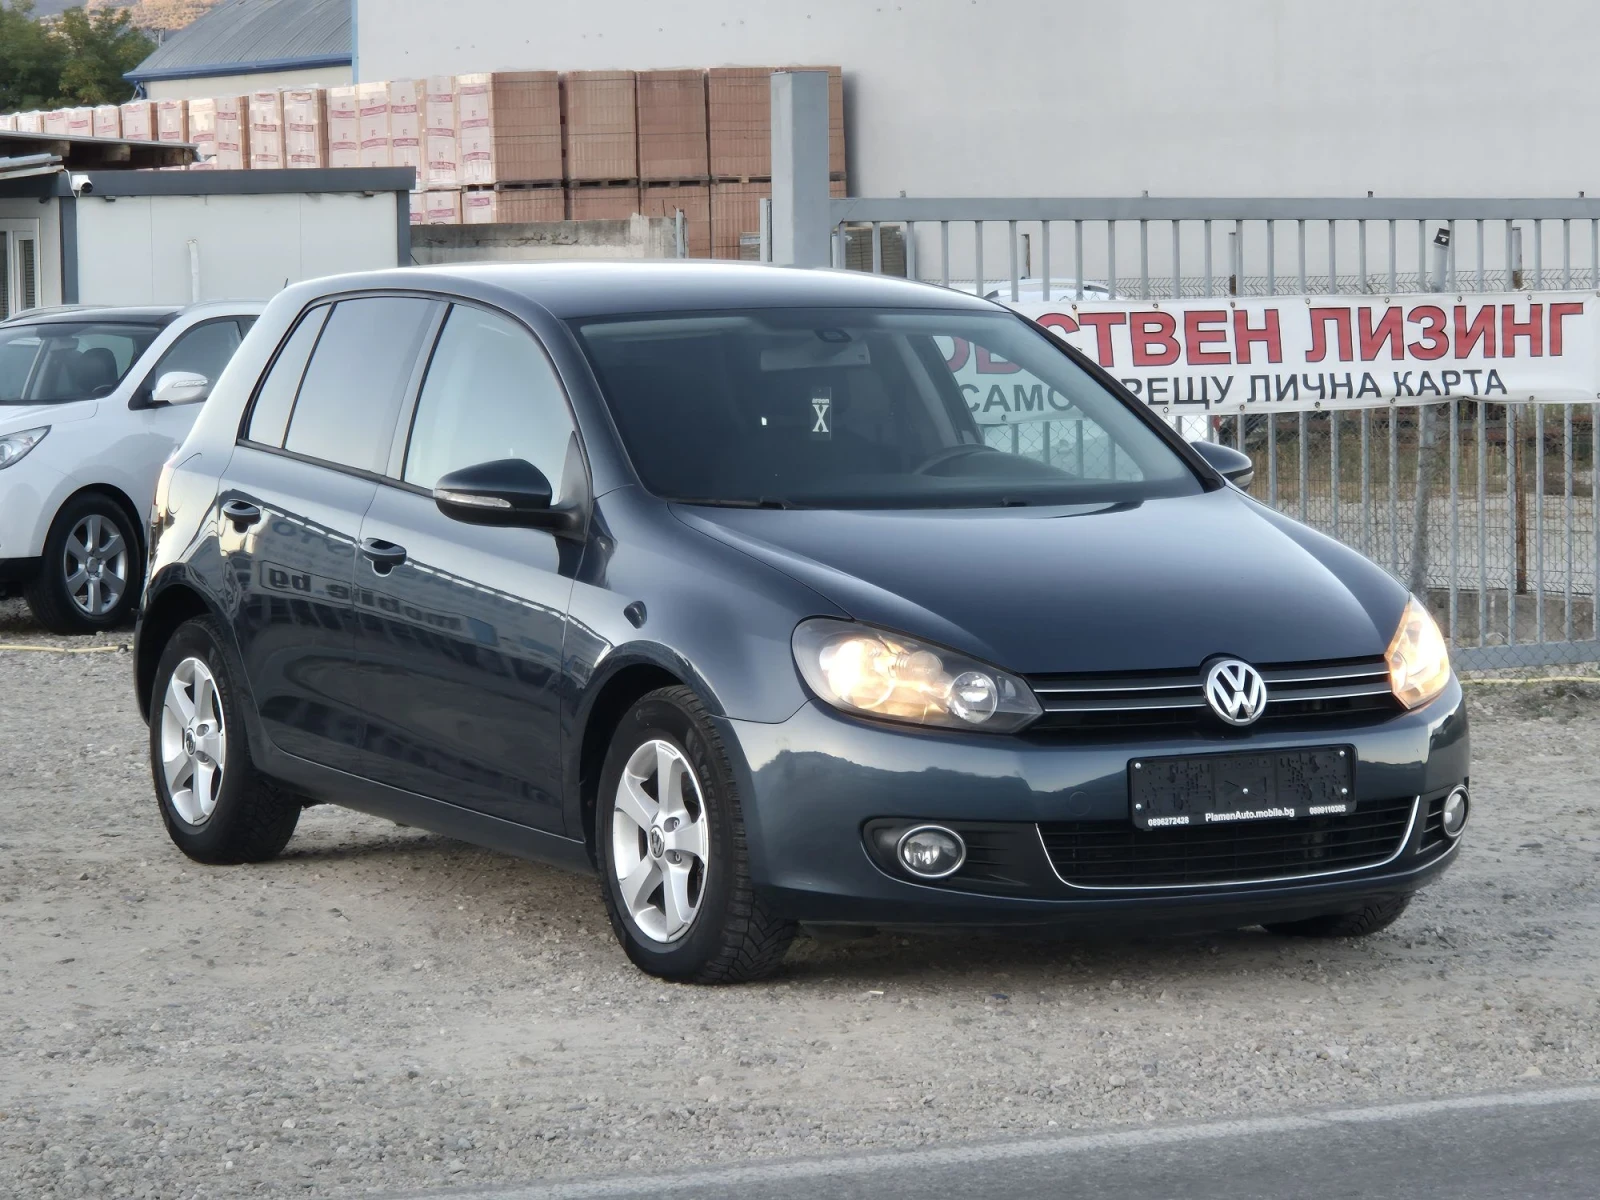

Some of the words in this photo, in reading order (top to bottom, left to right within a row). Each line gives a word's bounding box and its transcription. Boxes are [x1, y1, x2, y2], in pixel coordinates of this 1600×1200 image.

[1305, 302, 1584, 363] ЛИЗИНГ
[1247, 372, 1382, 404] ЛИЧНА
[1393, 369, 1508, 397] КАРТА
[812, 404, 829, 432] X
[1207, 660, 1267, 723] VW
[1204, 807, 1295, 822] PlamenAuto.mobile.bg
